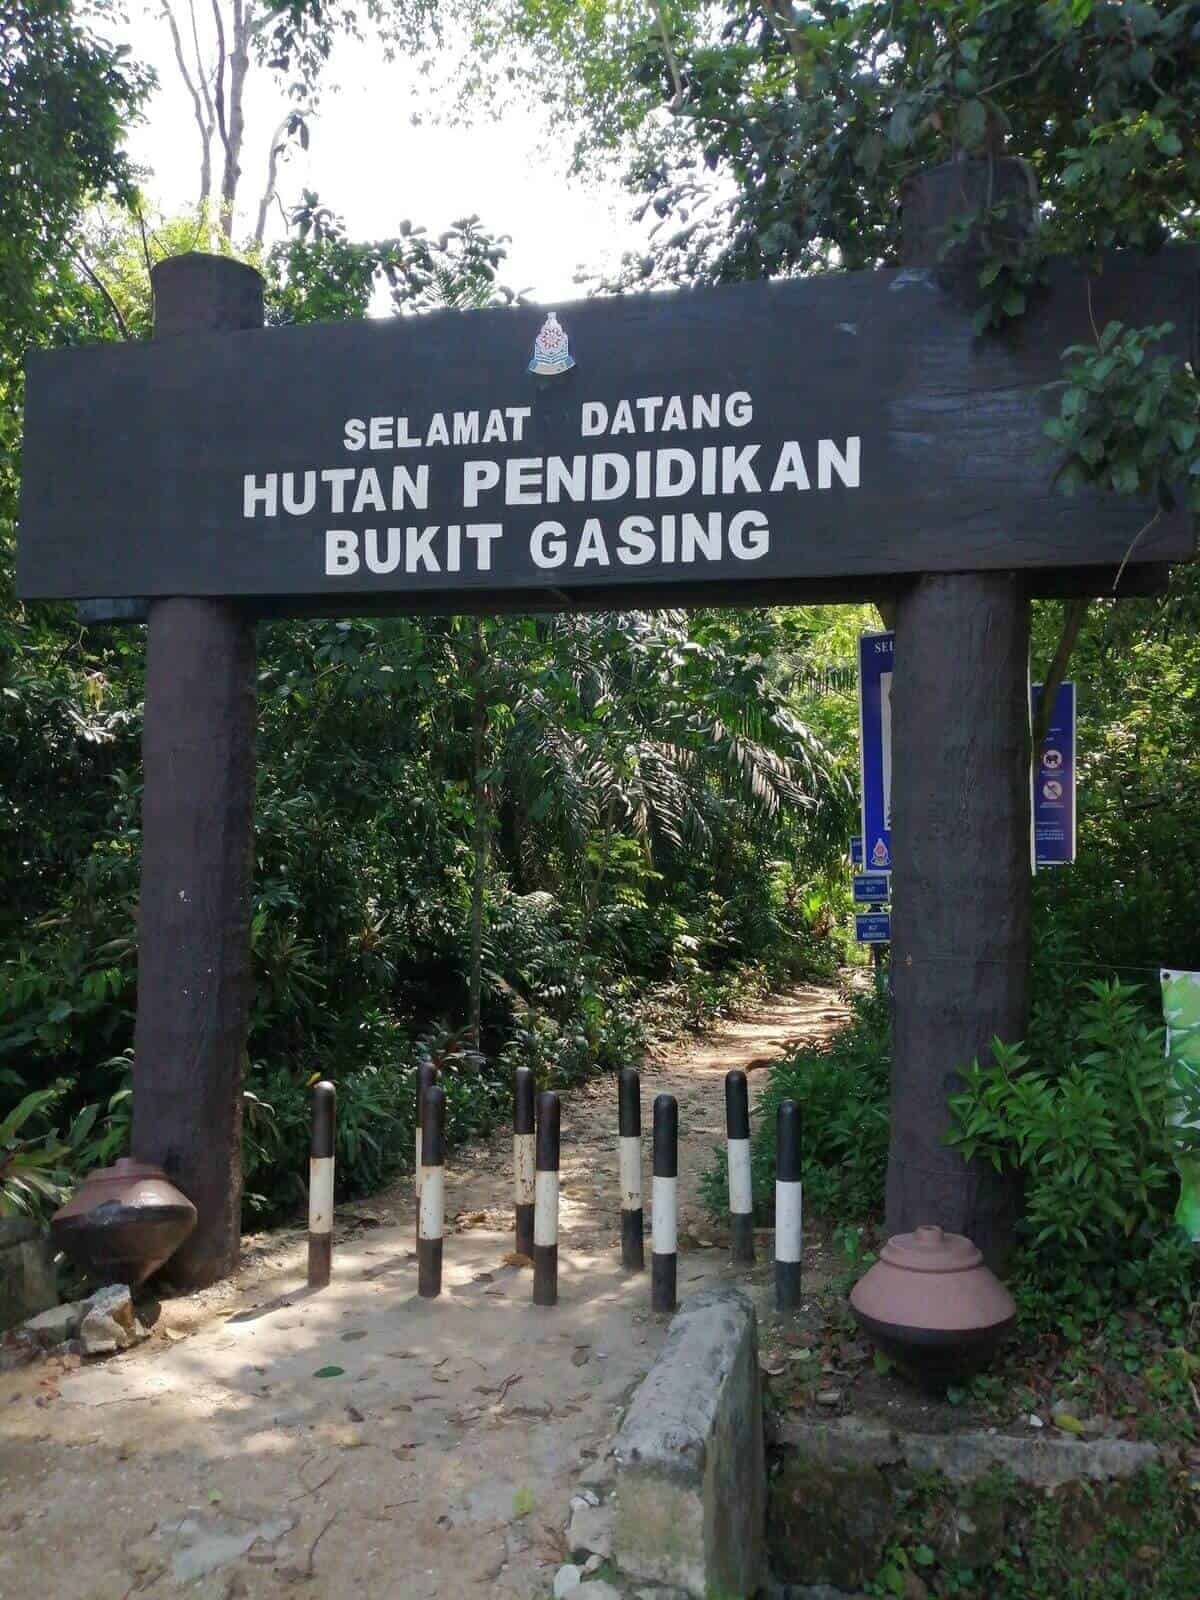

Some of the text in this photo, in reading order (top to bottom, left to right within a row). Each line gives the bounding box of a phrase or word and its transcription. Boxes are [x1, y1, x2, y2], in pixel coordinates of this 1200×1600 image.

[343, 391, 753, 452] SELAMAT DATANG
[243, 436, 861, 518] HUTAN PENDIDIKAN
[325, 509, 770, 576] BUKIT GASING
